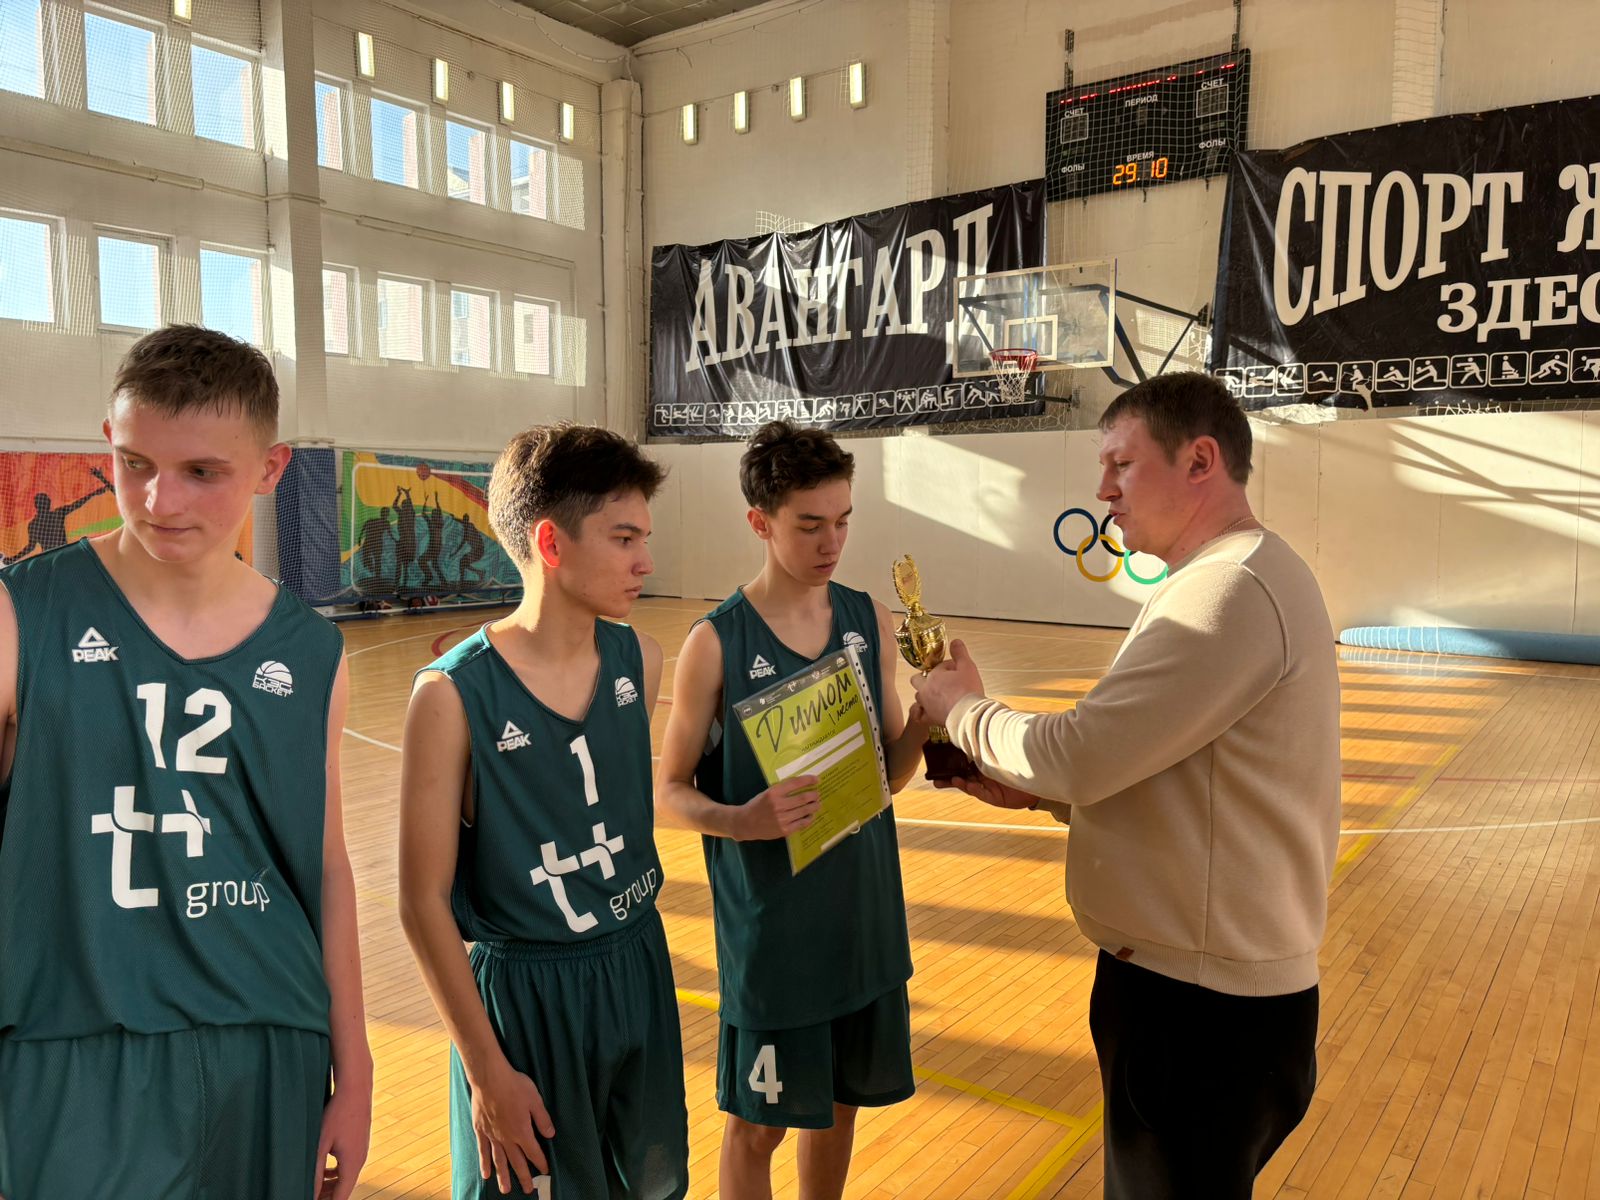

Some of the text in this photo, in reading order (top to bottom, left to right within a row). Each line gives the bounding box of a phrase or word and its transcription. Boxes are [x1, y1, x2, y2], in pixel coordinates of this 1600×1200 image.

[1201, 78, 1224, 89] СЧЕТ
[1125, 94, 1158, 108] ПЕРИОД
[1064, 108, 1084, 118] СЧЕТ
[1199, 138, 1226, 149] ФОЛЫ
[1127, 151, 1154, 162] ВРЕМЯ
[1061, 163, 1085, 174] ФОЛЫ
[1273, 166, 1524, 327] СПОРТ
[684, 202, 996, 373] АВАНГАРД
[72, 646, 119, 663] PEAK
[749, 665, 777, 680] PEAK
[136, 682, 232, 774] 12
[497, 733, 532, 752] PEAK
[569, 734, 600, 807] 1
[186, 879, 271, 919] group
[609, 867, 657, 921] group
[748, 1044, 783, 1104] 4
